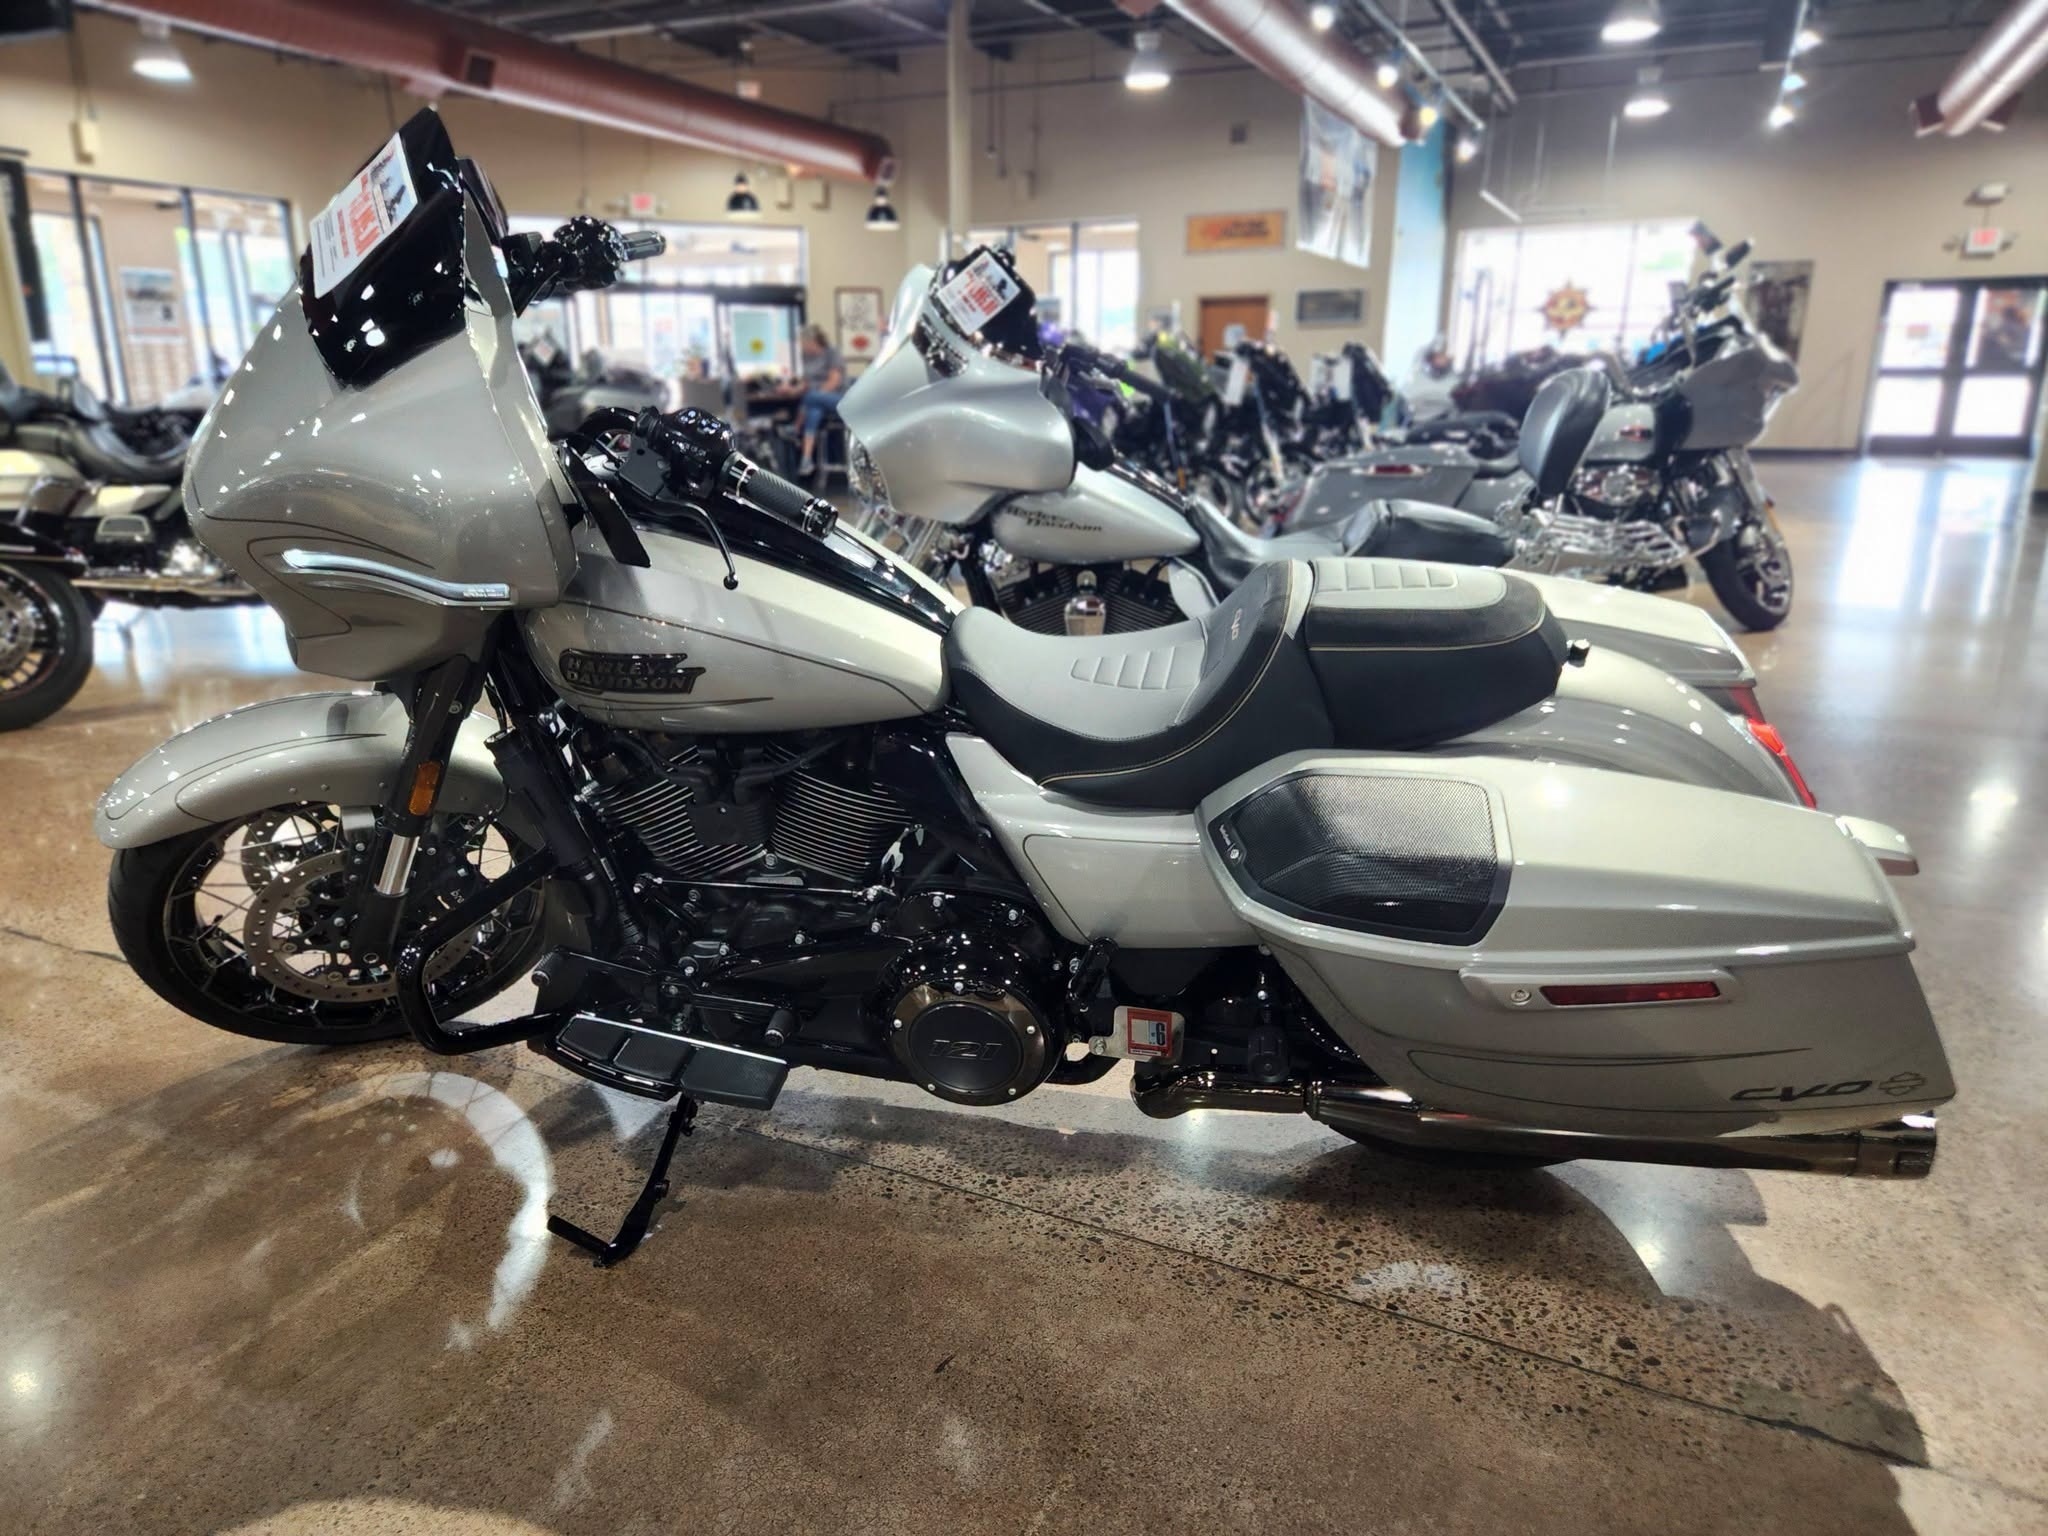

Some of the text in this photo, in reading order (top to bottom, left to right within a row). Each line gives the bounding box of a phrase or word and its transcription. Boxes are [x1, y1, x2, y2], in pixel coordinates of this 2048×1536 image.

[567, 656, 659, 675] HARLEY
[566, 670, 687, 690] DAVIDSON
[1729, 1080, 1873, 1102] CVO
